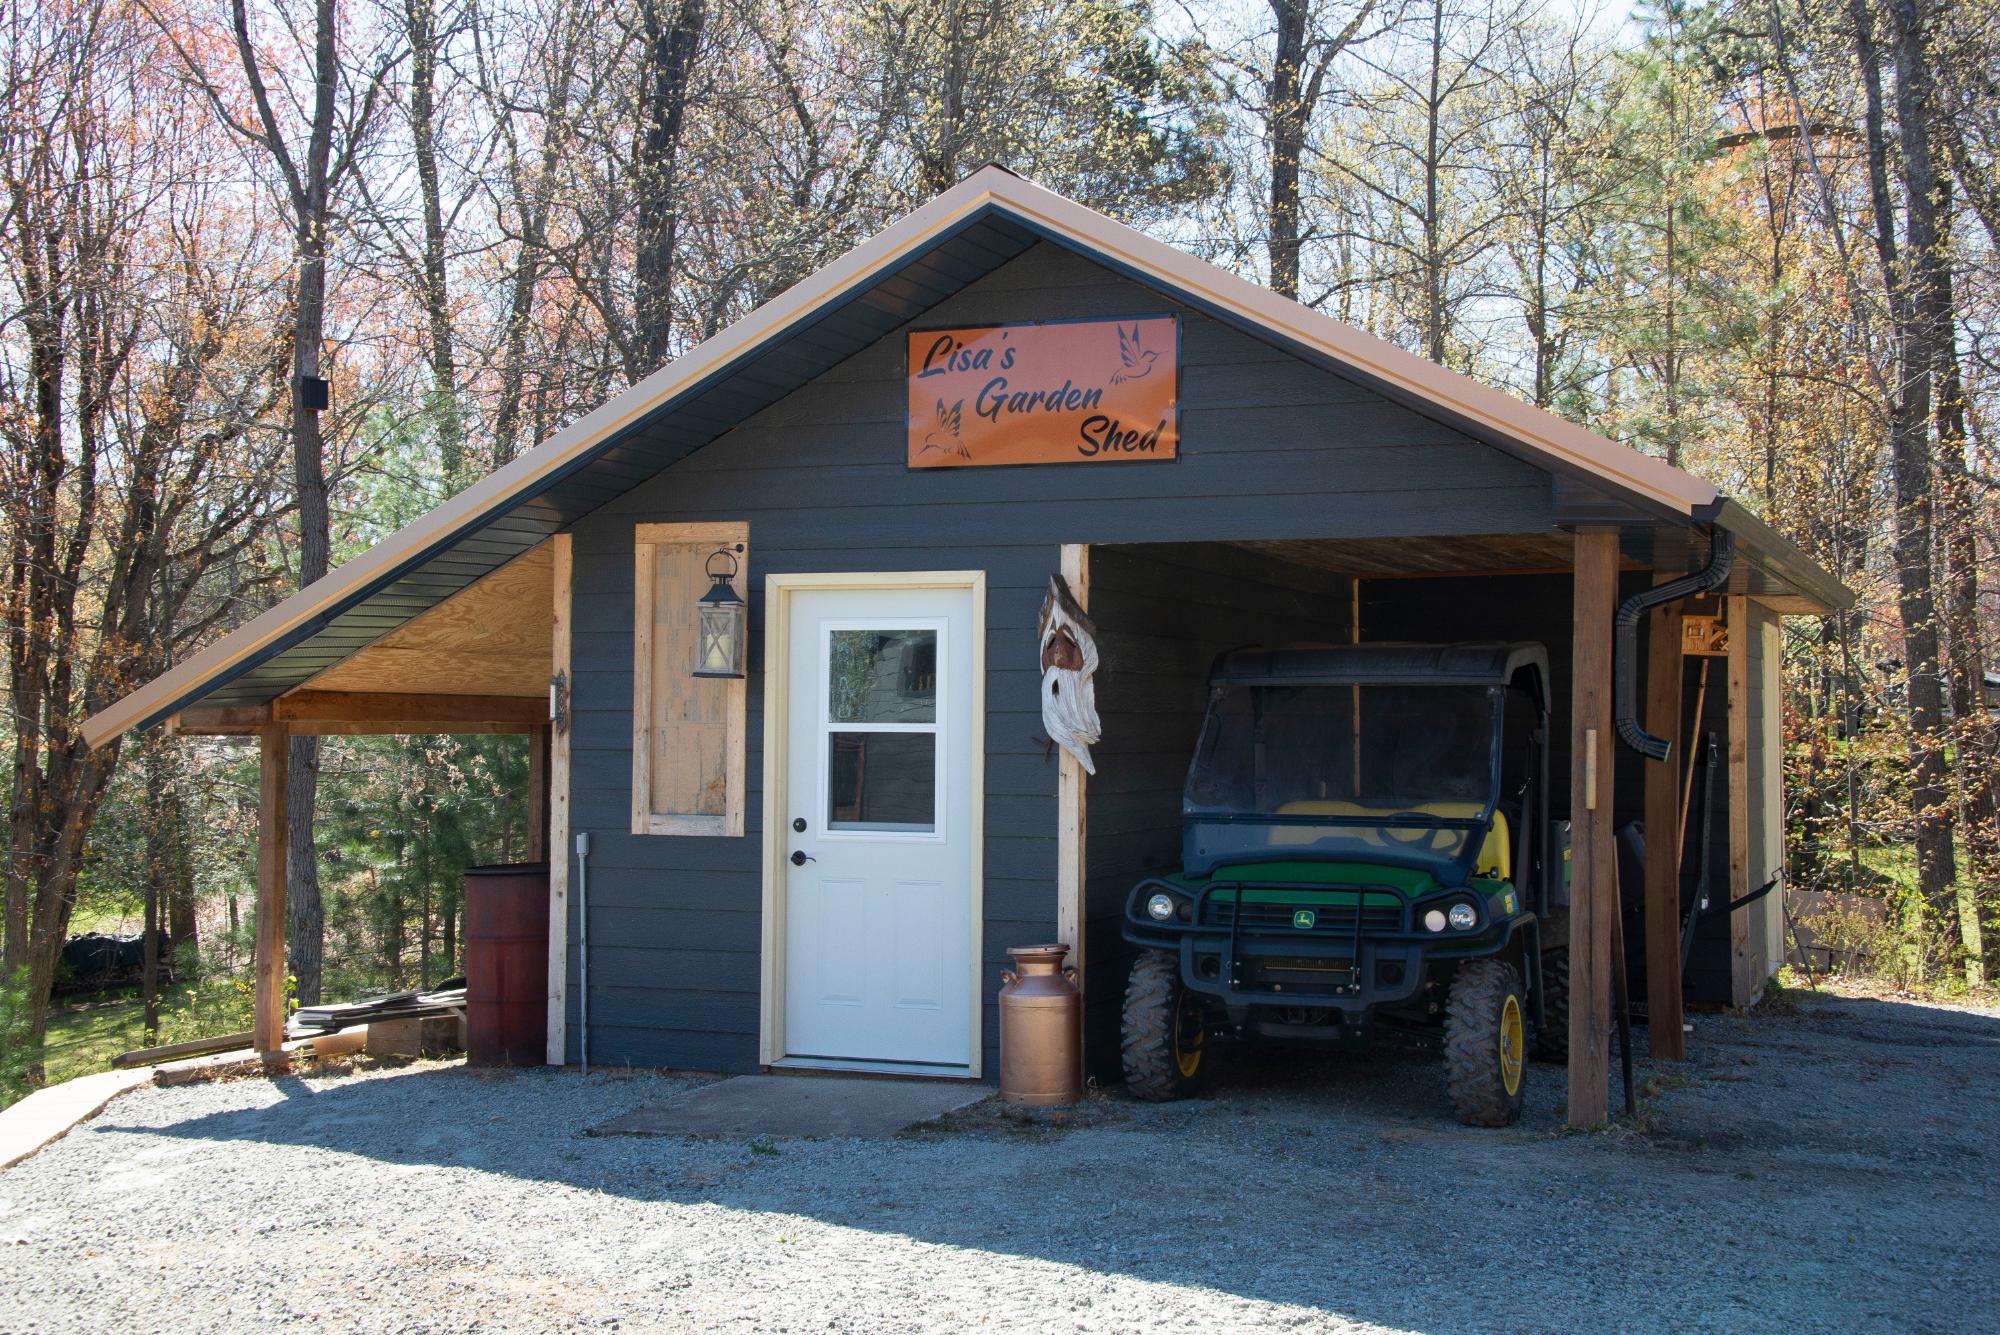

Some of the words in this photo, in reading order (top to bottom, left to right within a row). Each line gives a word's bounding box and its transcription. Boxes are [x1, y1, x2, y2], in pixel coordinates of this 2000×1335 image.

[917, 332, 1016, 378] Lisa's
[975, 376, 1103, 423] Garden
[1077, 415, 1167, 457] Shed
